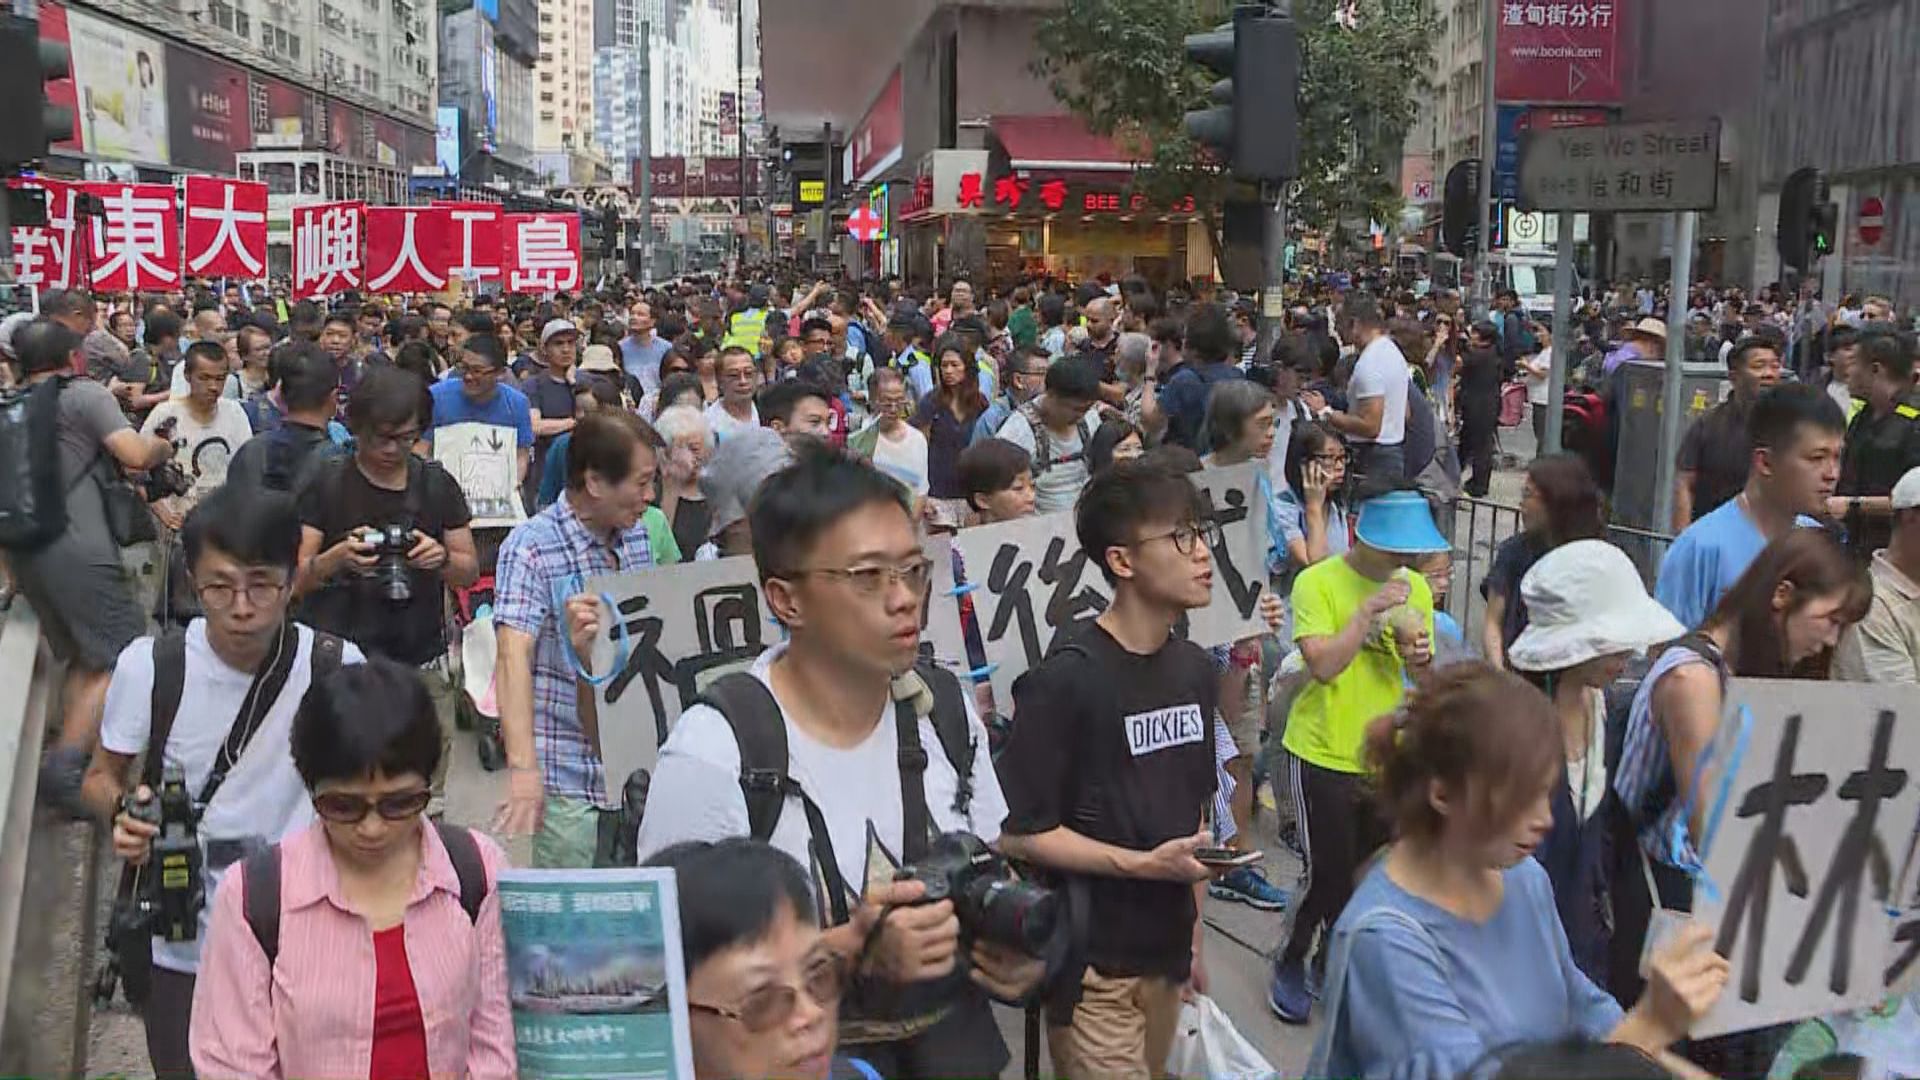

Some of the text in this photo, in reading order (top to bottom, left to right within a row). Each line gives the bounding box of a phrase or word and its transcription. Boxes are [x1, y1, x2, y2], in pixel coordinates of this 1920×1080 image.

[1503, 3, 1612, 27] 渣甸街分行
[1511, 45, 1602, 58] www.bochk.com
[1642, 129, 1711, 155] Street
[1085, 194, 1120, 210] BEE
[1133, 709, 1199, 749] DICKIES
